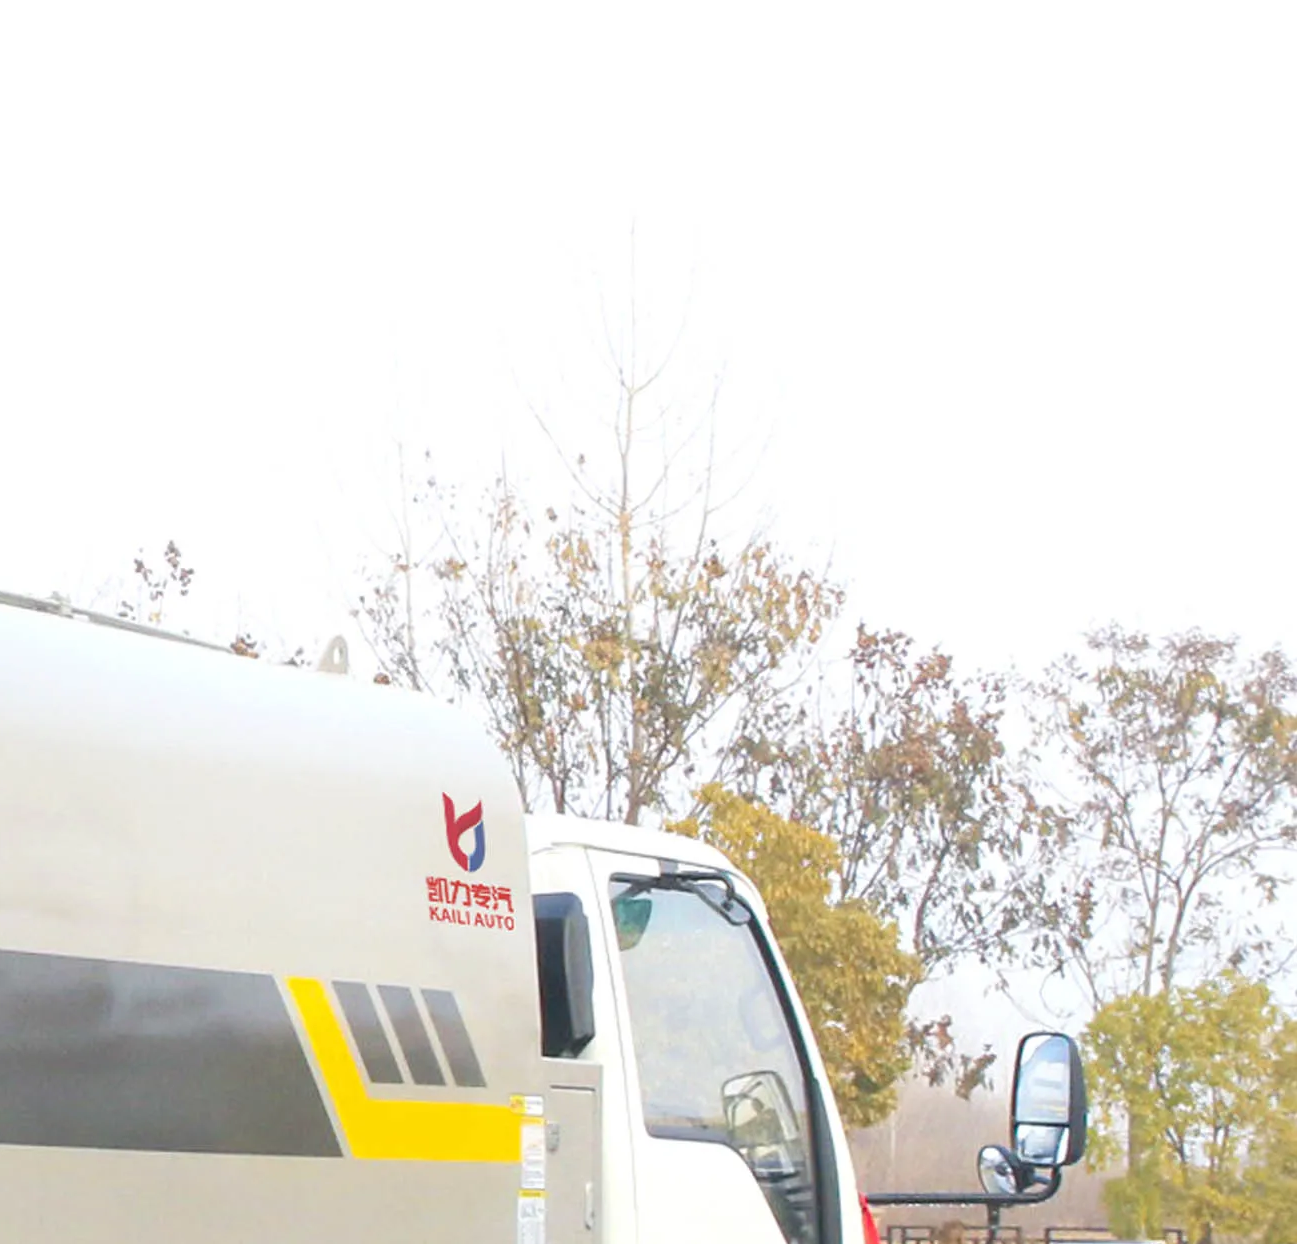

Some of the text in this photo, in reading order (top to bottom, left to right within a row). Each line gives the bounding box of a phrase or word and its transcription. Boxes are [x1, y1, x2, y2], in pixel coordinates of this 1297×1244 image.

[426, 876, 514, 913] 凯力专汽
[429, 906, 515, 931] KAILI AUTO
